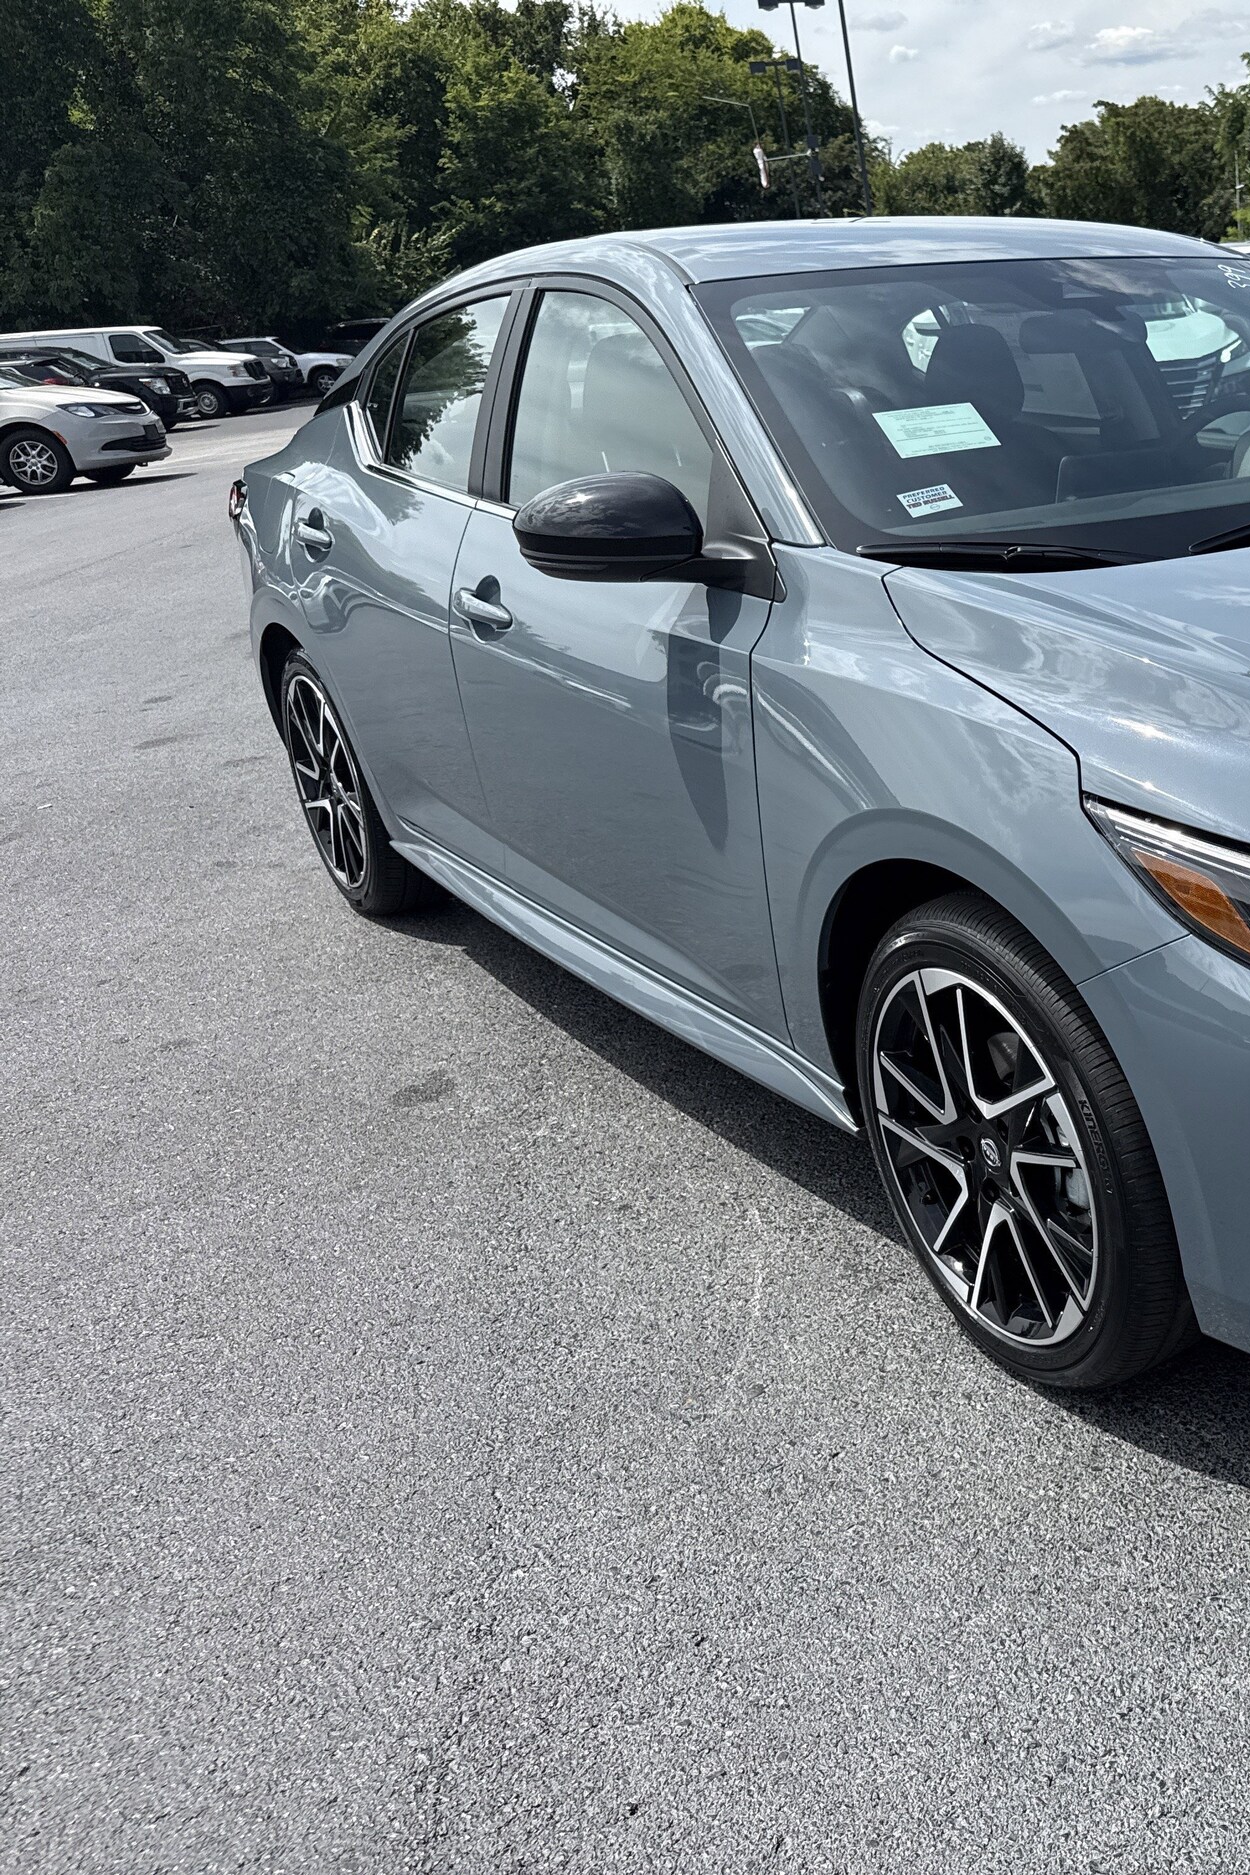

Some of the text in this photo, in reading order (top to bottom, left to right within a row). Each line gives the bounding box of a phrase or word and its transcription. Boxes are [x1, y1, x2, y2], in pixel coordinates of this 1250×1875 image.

[902, 486, 945, 499] PREFERRED
[906, 490, 947, 504] CUSTOMER
[906, 494, 955, 509] TED RUSSELL
